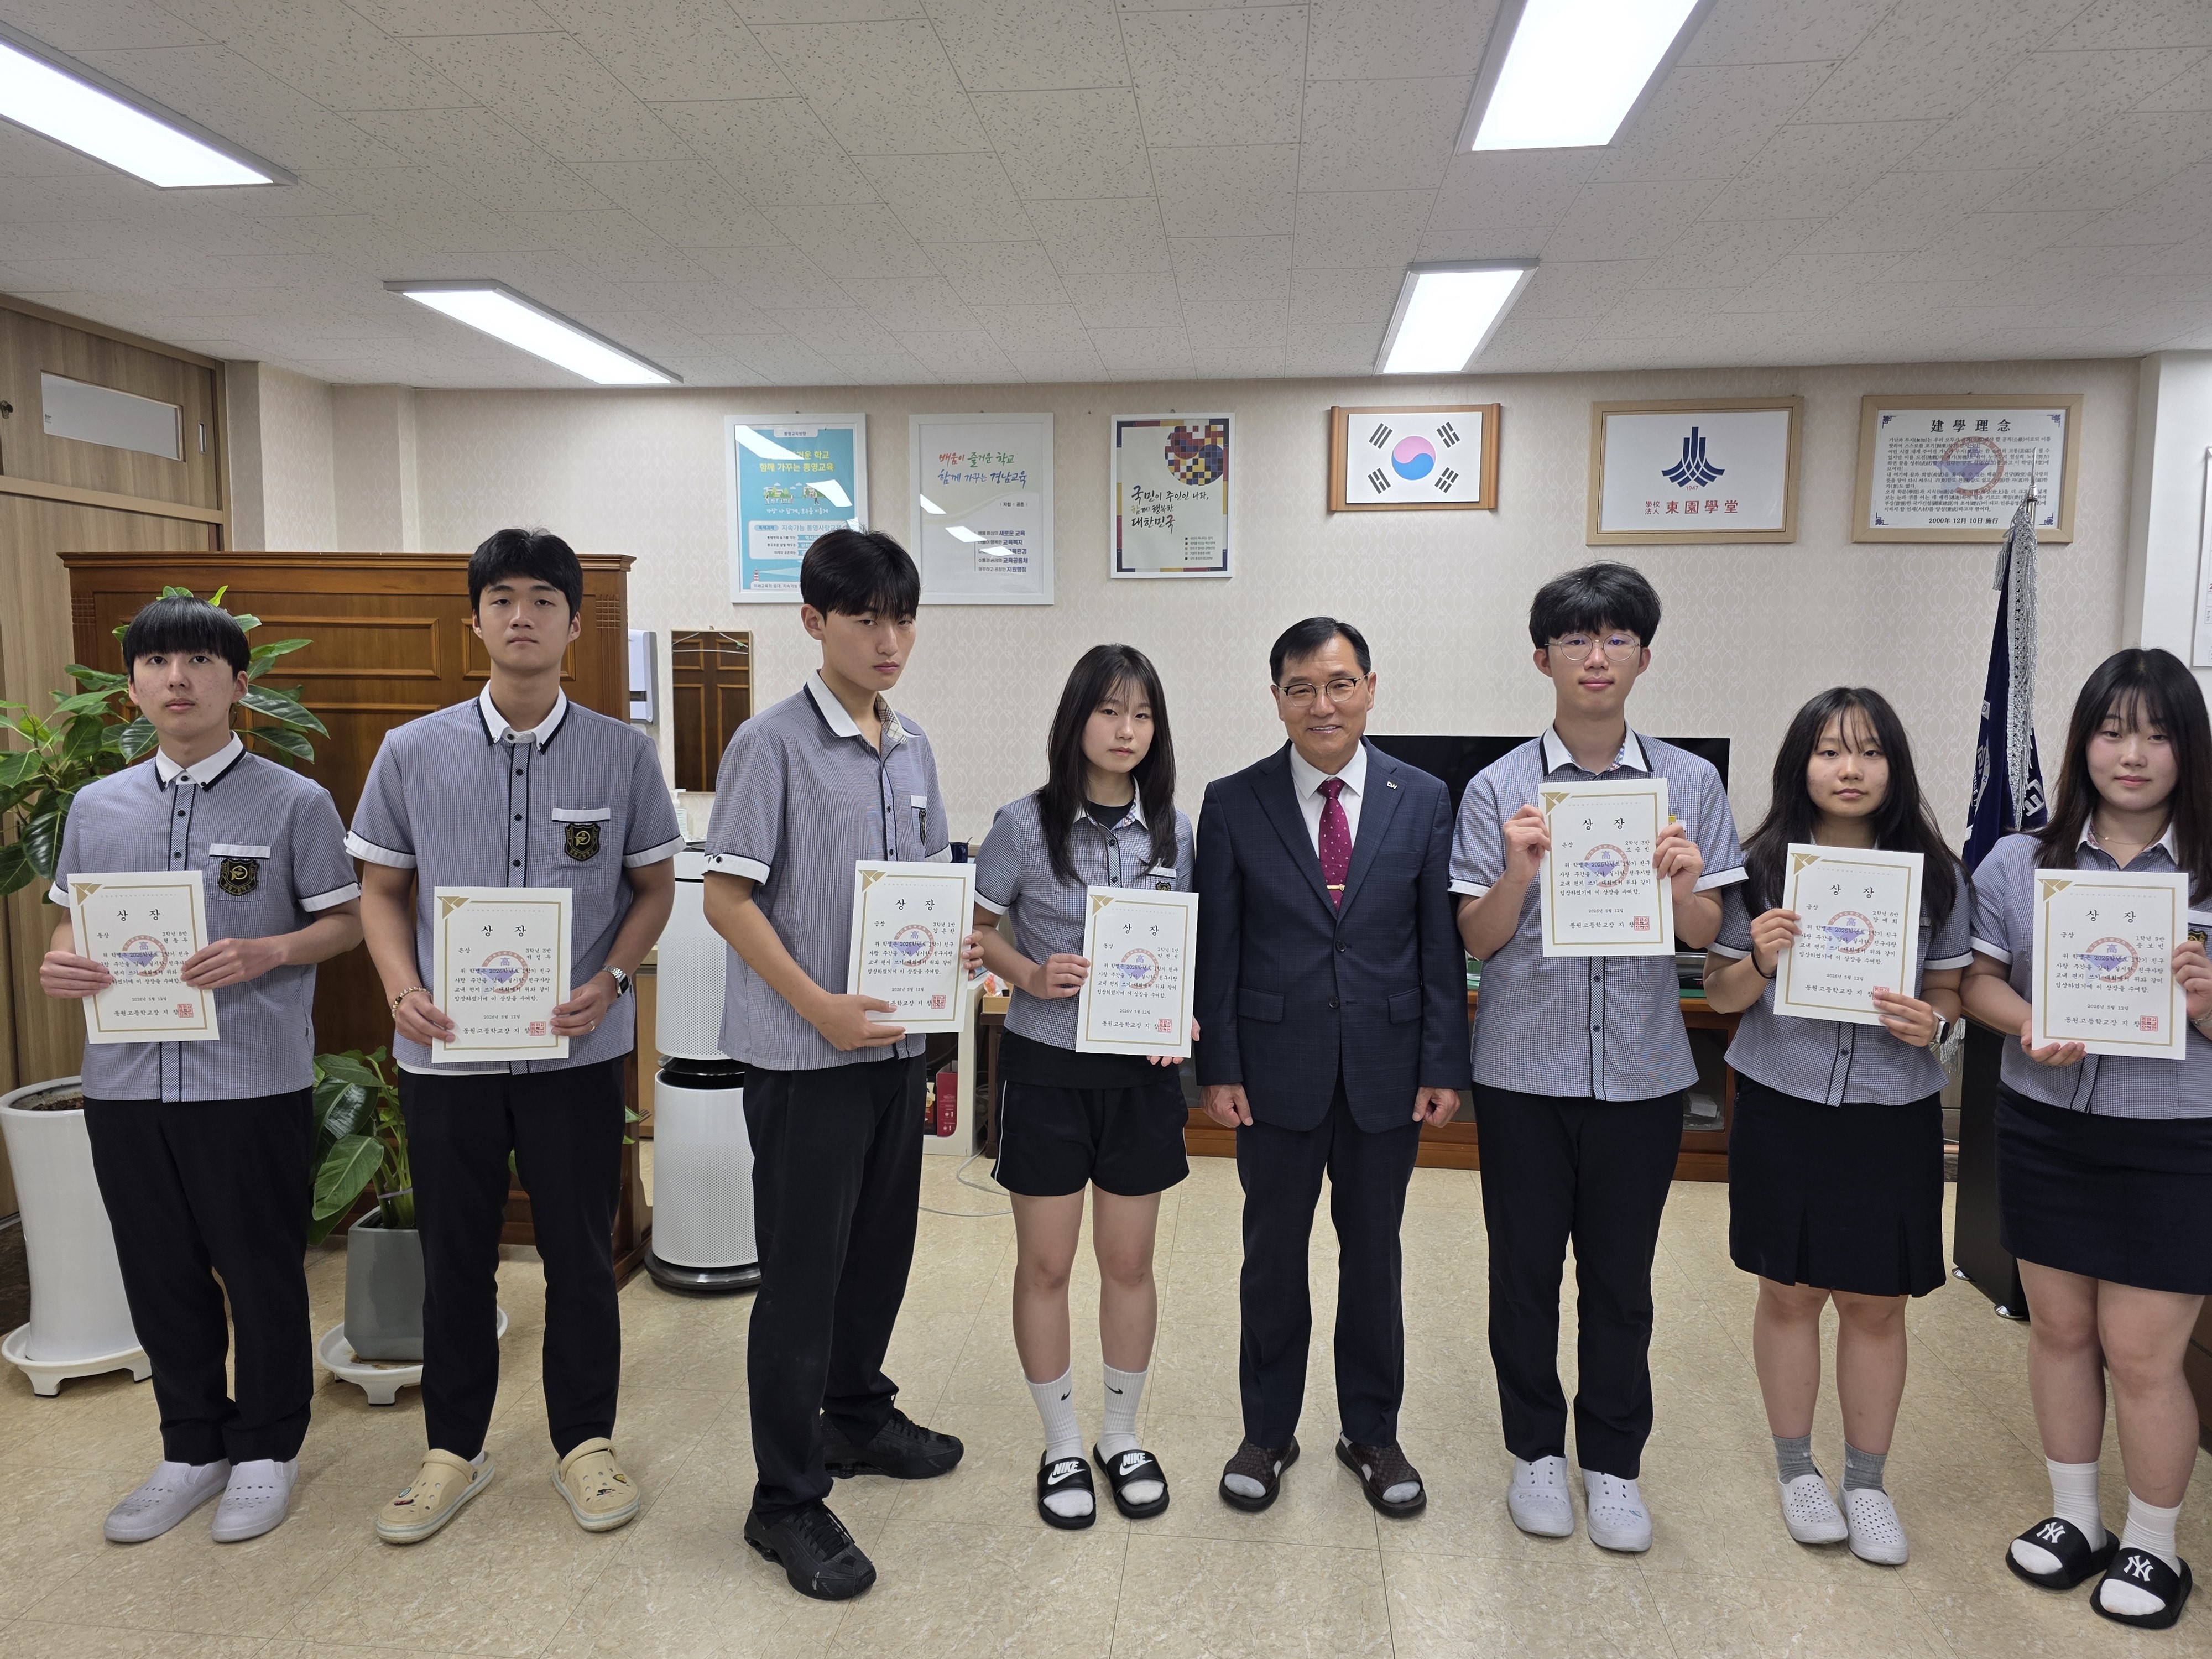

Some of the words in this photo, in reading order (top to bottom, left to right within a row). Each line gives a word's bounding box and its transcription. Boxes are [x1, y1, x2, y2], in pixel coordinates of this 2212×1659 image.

[1931, 419, 2010, 432] 建學理念
[940, 453, 964, 466] 배움이
[967, 452, 993, 468] 즐거운
[995, 452, 1015, 463] 학교
[760, 463, 774, 472] 함께
[778, 463, 800, 472] 가꾸는
[804, 463, 833, 472] 통영교육
[938, 469, 961, 484] 함께
[964, 474, 987, 483] 가꾸는
[990, 471, 1027, 489] 경남교육
[1131, 485, 1162, 505] 국민이
[1166, 491, 1189, 500] 주인인
[1192, 492, 1209, 500] 나라,
[1131, 505, 1150, 515] 함께
[1666, 500, 1738, 514] 東園學堂
[1131, 515, 1175, 534] 대한민국
[1583, 818, 1593, 830] 상
[1614, 818, 1624, 829] 장
[1587, 845, 1617, 858] DONGWON
[1601, 851, 1610, 859] 高
[1831, 884, 1841, 895] 상
[1864, 887, 1874, 898] 장
[896, 899, 905, 910] 상
[925, 899, 935, 910] 장
[117, 910, 128, 921] 상
[150, 909, 160, 920] 장
[1831, 911, 1864, 922] DONGWON
[2086, 910, 2099, 921] 상
[2124, 911, 2136, 923] 장
[1846, 917, 1856, 926] 高
[482, 925, 493, 936] 상
[515, 925, 526, 937] 장
[897, 925, 926, 937] DONGWON
[910, 931, 919, 940] 高
[1123, 924, 1132, 934] 상
[1150, 925, 1159, 936] 장
[139, 942, 148, 951] 高
[2089, 938, 2125, 950] DONGWON
[2107, 944, 2117, 953] 高
[484, 952, 517, 964] DONGWON
[500, 957, 510, 966] 高
[1136, 954, 1144, 963] 高
[1805, 985, 1853, 995] 동원고등학교장
[2065, 1017, 2117, 1026] 동원고등학교장
[1123, 1453, 1145, 1465] NIKE
[1053, 1461, 1079, 1475] NIKE
[2036, 1522, 2065, 1543] NY
[2124, 1556, 2153, 1581] NY
